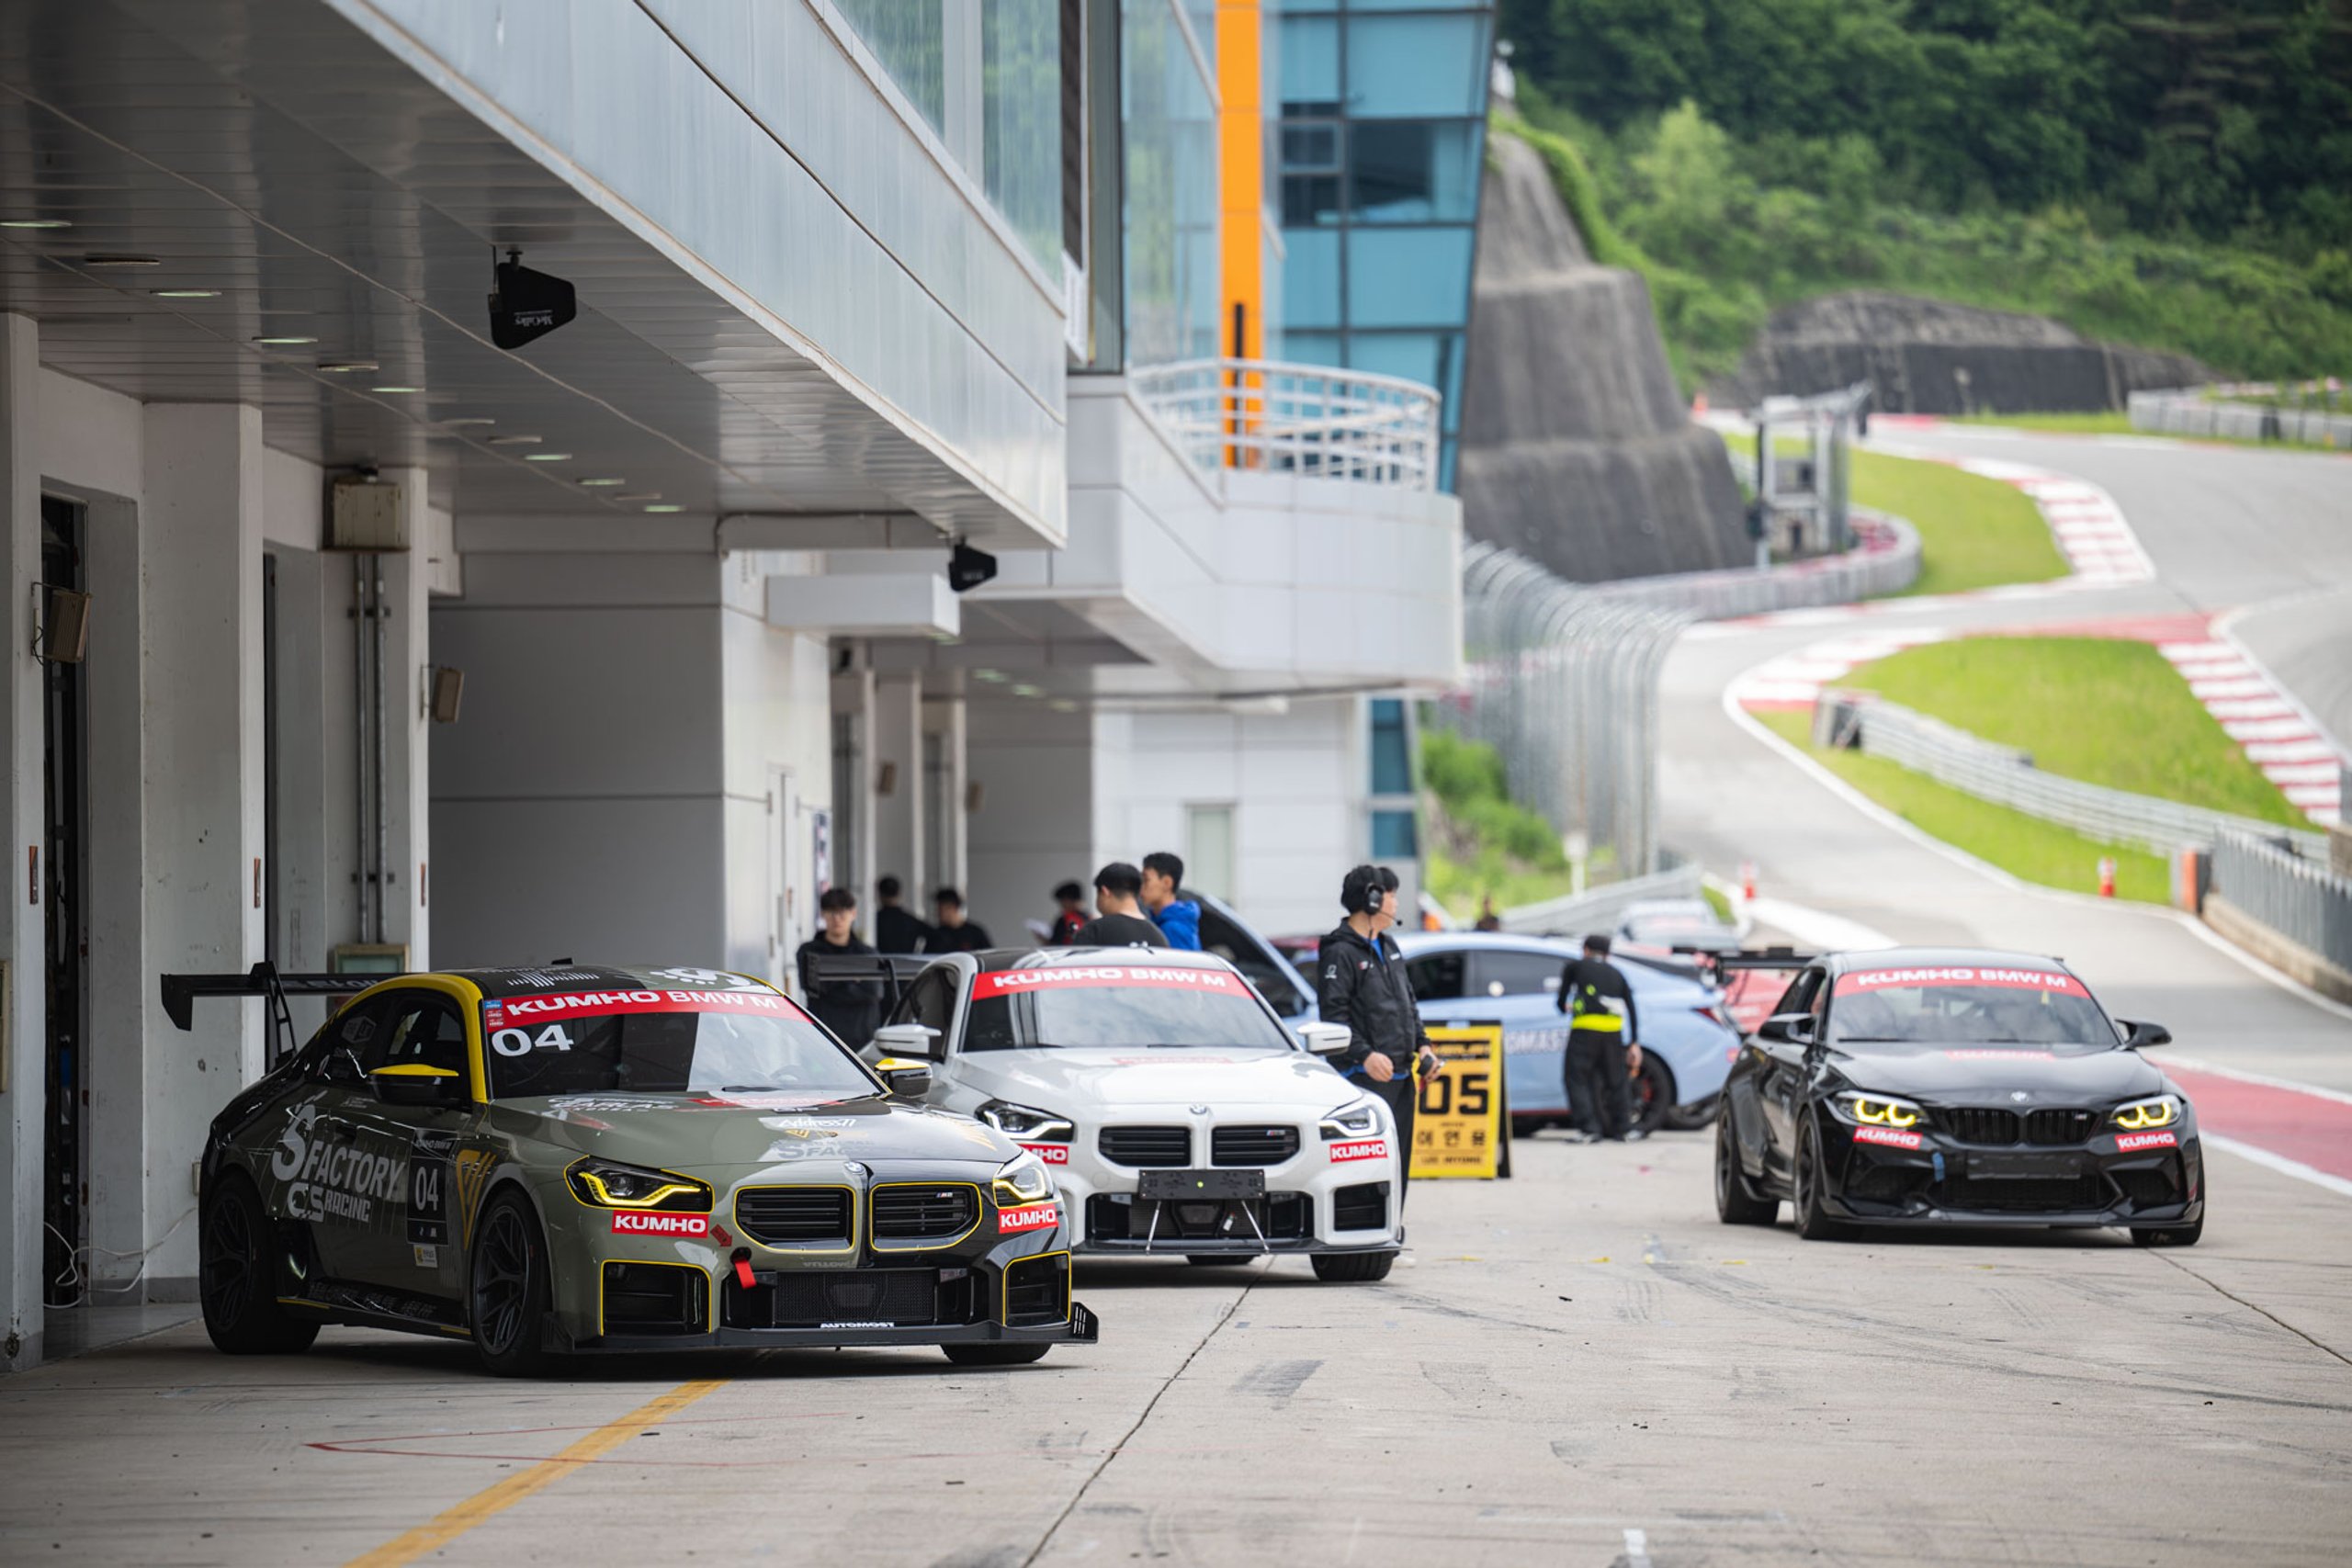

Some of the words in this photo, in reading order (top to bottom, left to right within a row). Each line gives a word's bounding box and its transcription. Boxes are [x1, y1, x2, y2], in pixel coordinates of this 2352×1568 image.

[994, 967, 1124, 988] KUMHO
[1132, 969, 1199, 984] BMW
[1202, 973, 1227, 987] M
[1858, 968, 1973, 987] KUMHO
[1981, 969, 2041, 984] BMW
[2045, 975, 2067, 987] M
[506, 990, 661, 1017] KUMHO
[667, 991, 744, 1006] BMW
[749, 996, 778, 1010] M
[492, 1024, 574, 1056] 04
[1419, 1074, 1488, 1115] 05
[1855, 1130, 1920, 1145] KUMHO
[2118, 1134, 2175, 1149] KUMHO
[1331, 1142, 1385, 1160] KUMHO
[301, 1140, 406, 1200] FACTORY
[414, 1167, 439, 1212] 04
[323, 1190, 371, 1223] RACING
[615, 1215, 707, 1233] KUMHO
[1001, 1209, 1056, 1227] KUMHO
